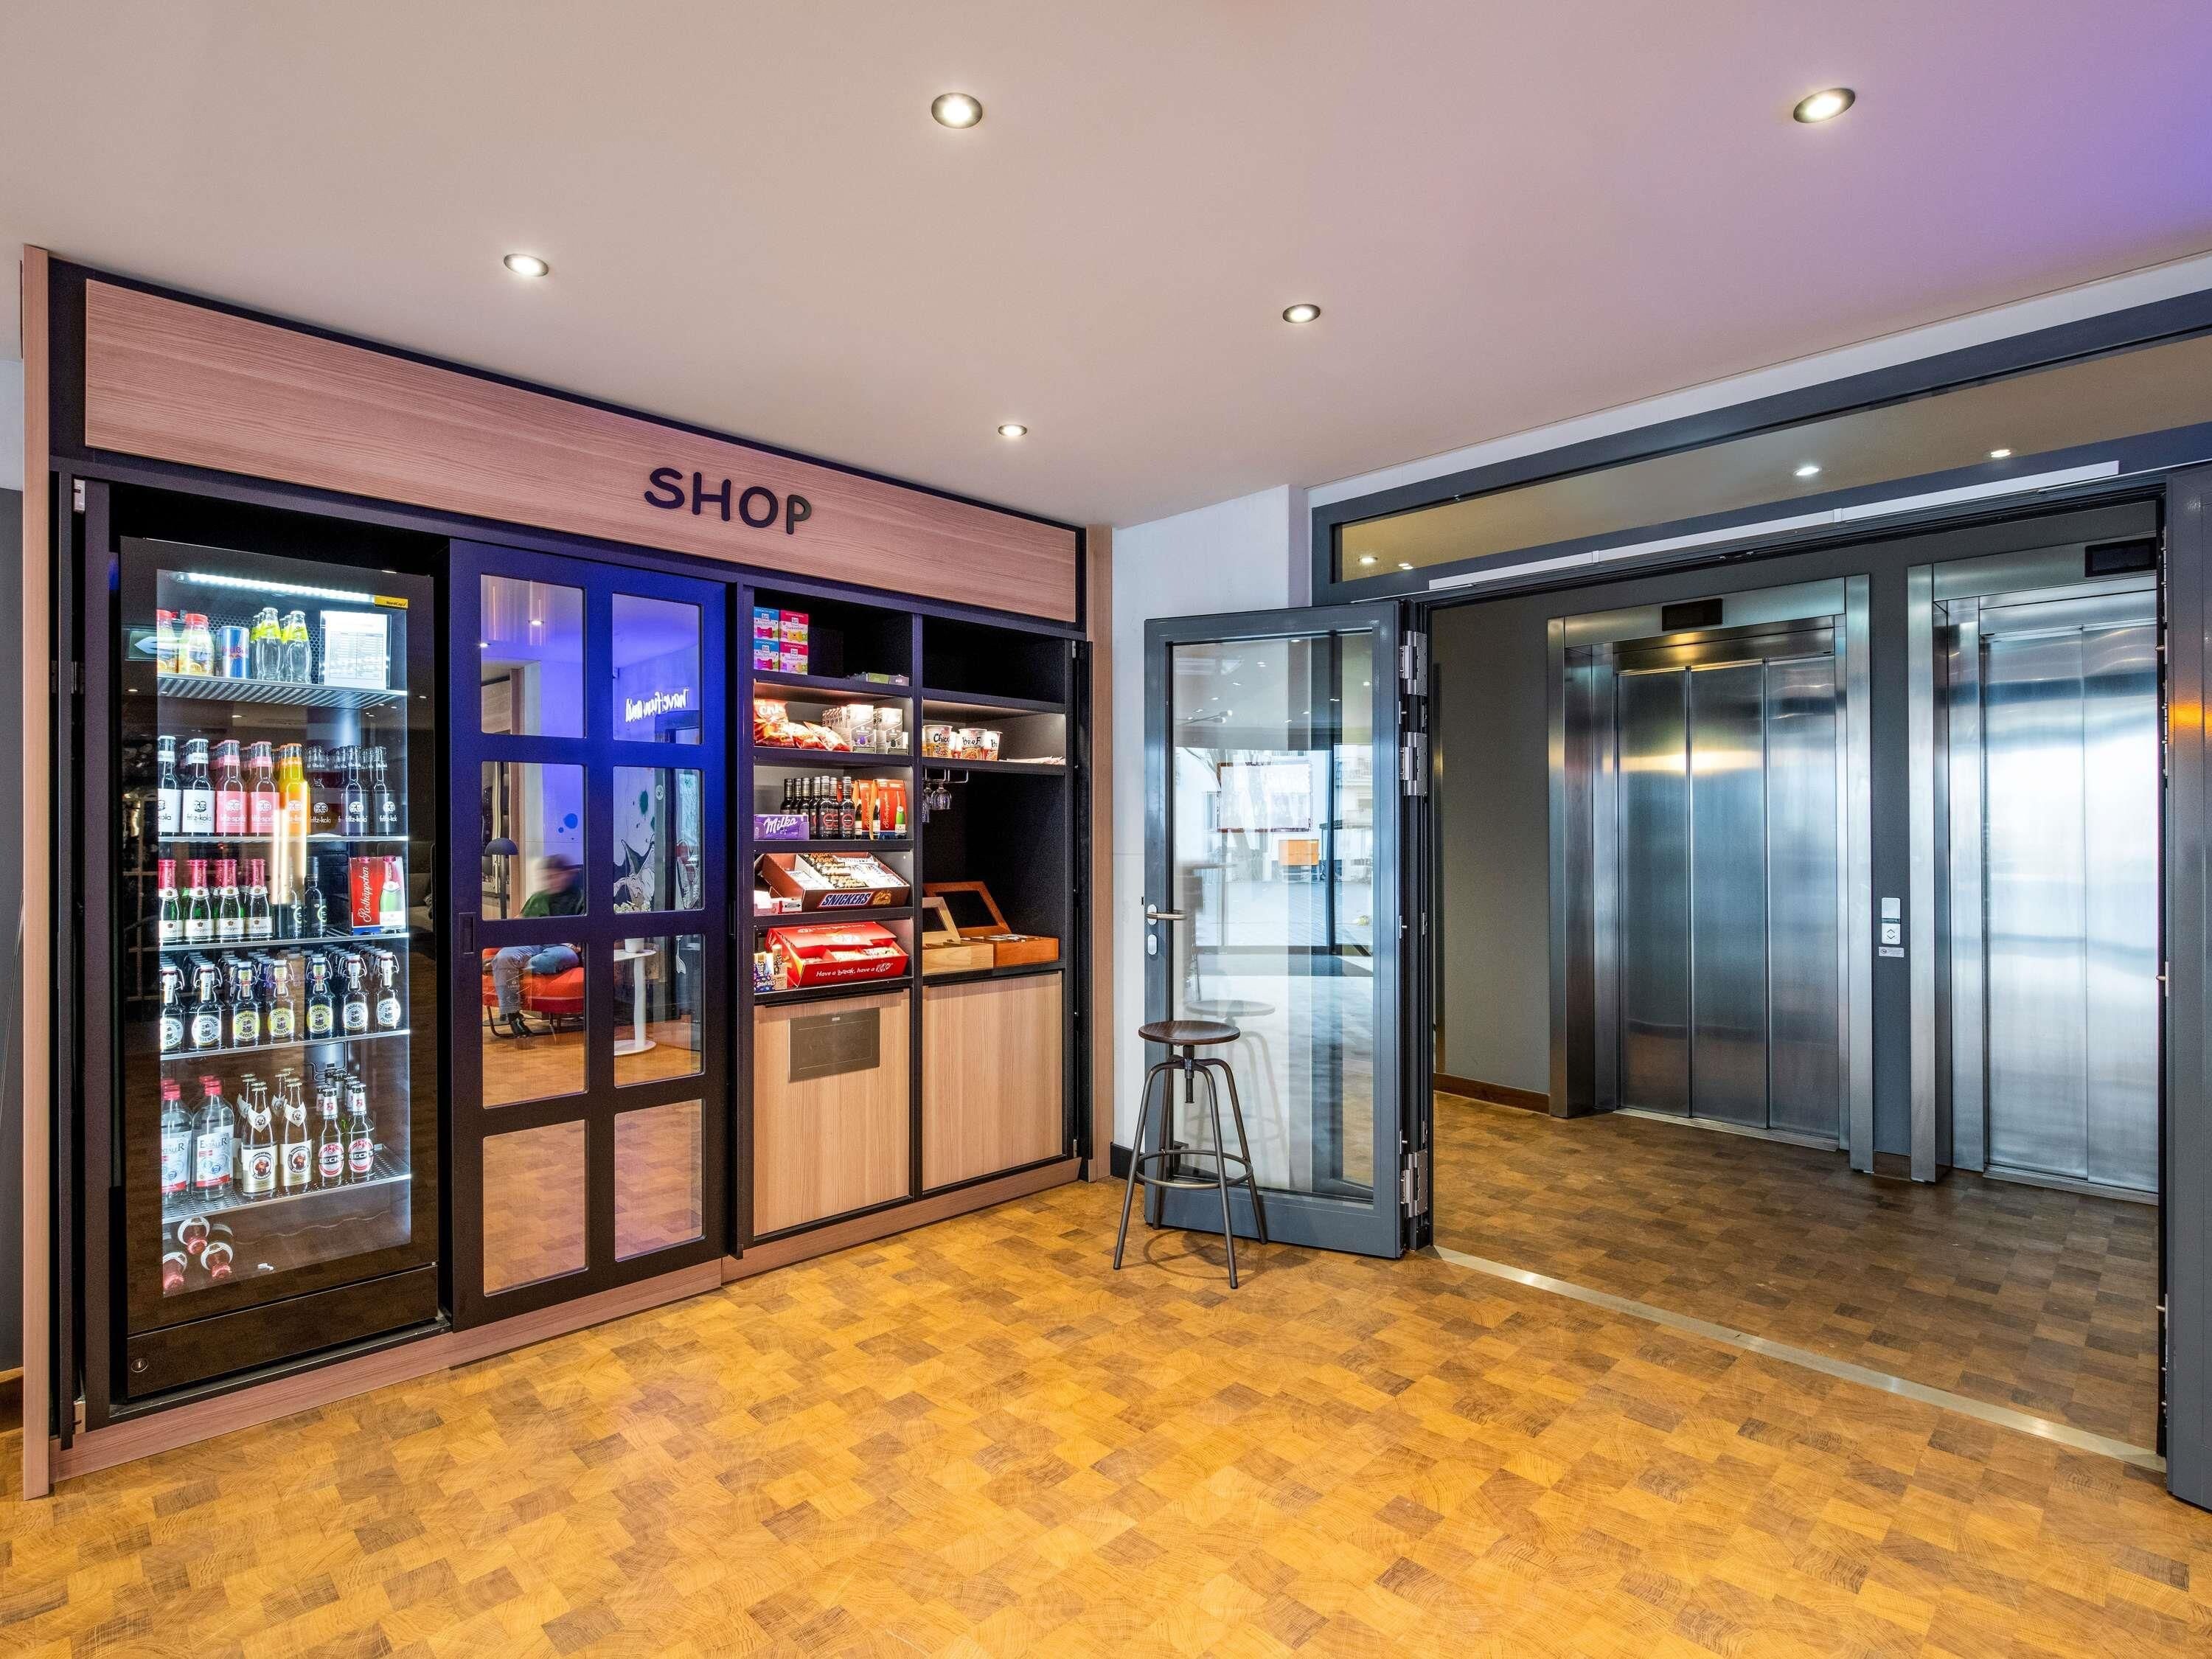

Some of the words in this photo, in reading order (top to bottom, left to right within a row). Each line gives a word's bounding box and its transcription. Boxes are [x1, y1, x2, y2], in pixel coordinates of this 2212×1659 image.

[644, 467, 812, 535] SHOP
[763, 815, 797, 834] Milka
[822, 893, 871, 906] SNICKERS
